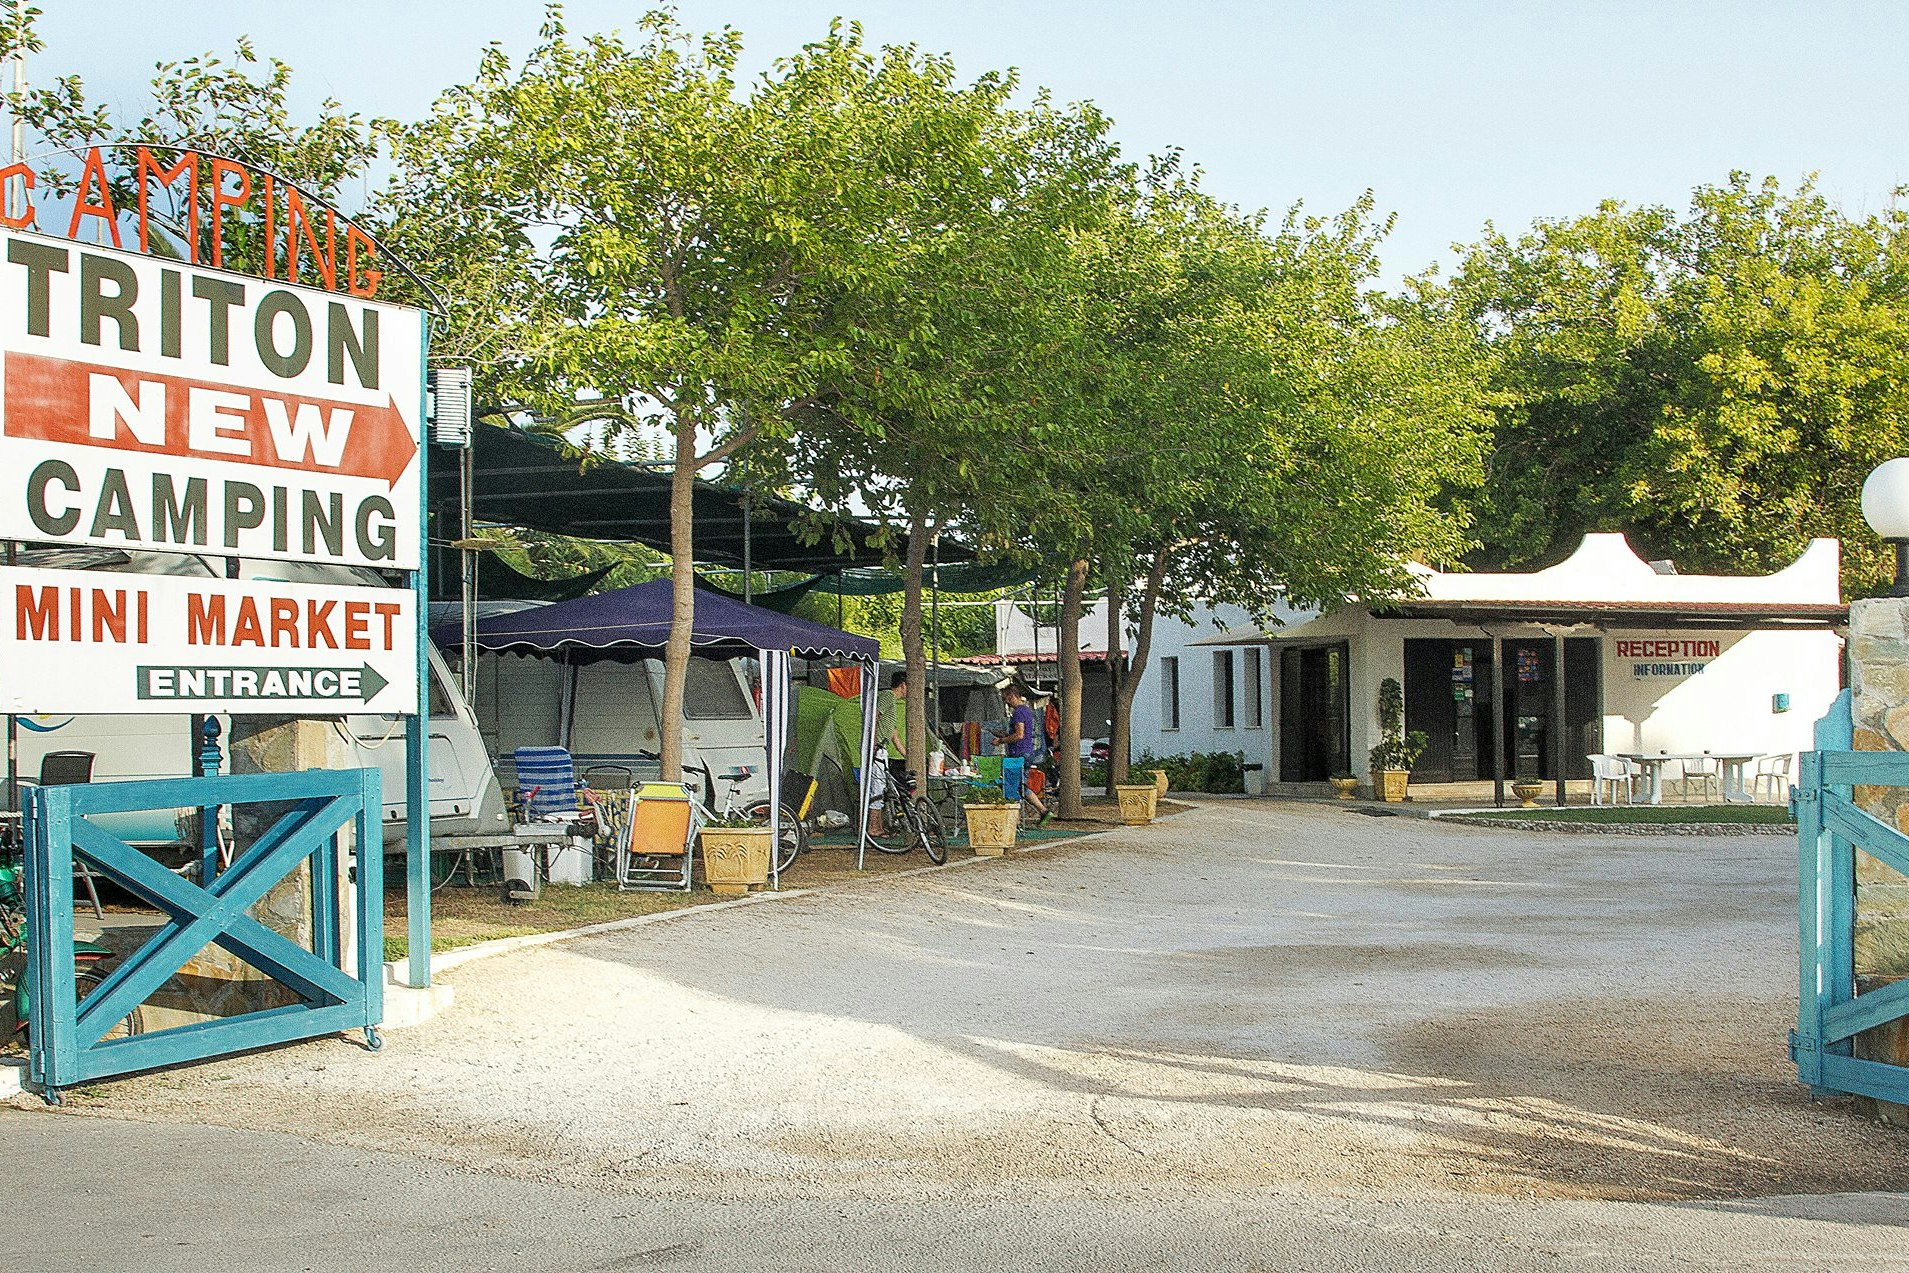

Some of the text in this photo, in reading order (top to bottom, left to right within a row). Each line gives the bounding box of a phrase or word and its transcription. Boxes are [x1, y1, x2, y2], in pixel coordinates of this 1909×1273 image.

[0, 147, 383, 298] CAMPING
[8, 238, 380, 390] TRITON
[89, 372, 356, 468] NEW
[27, 459, 397, 562] CAMPING
[15, 584, 402, 651] MINI MARKET
[1616, 640, 1720, 657] RECEPTION
[149, 669, 363, 698] ENTRANCE
[1633, 663, 1705, 676] INFORMATION
